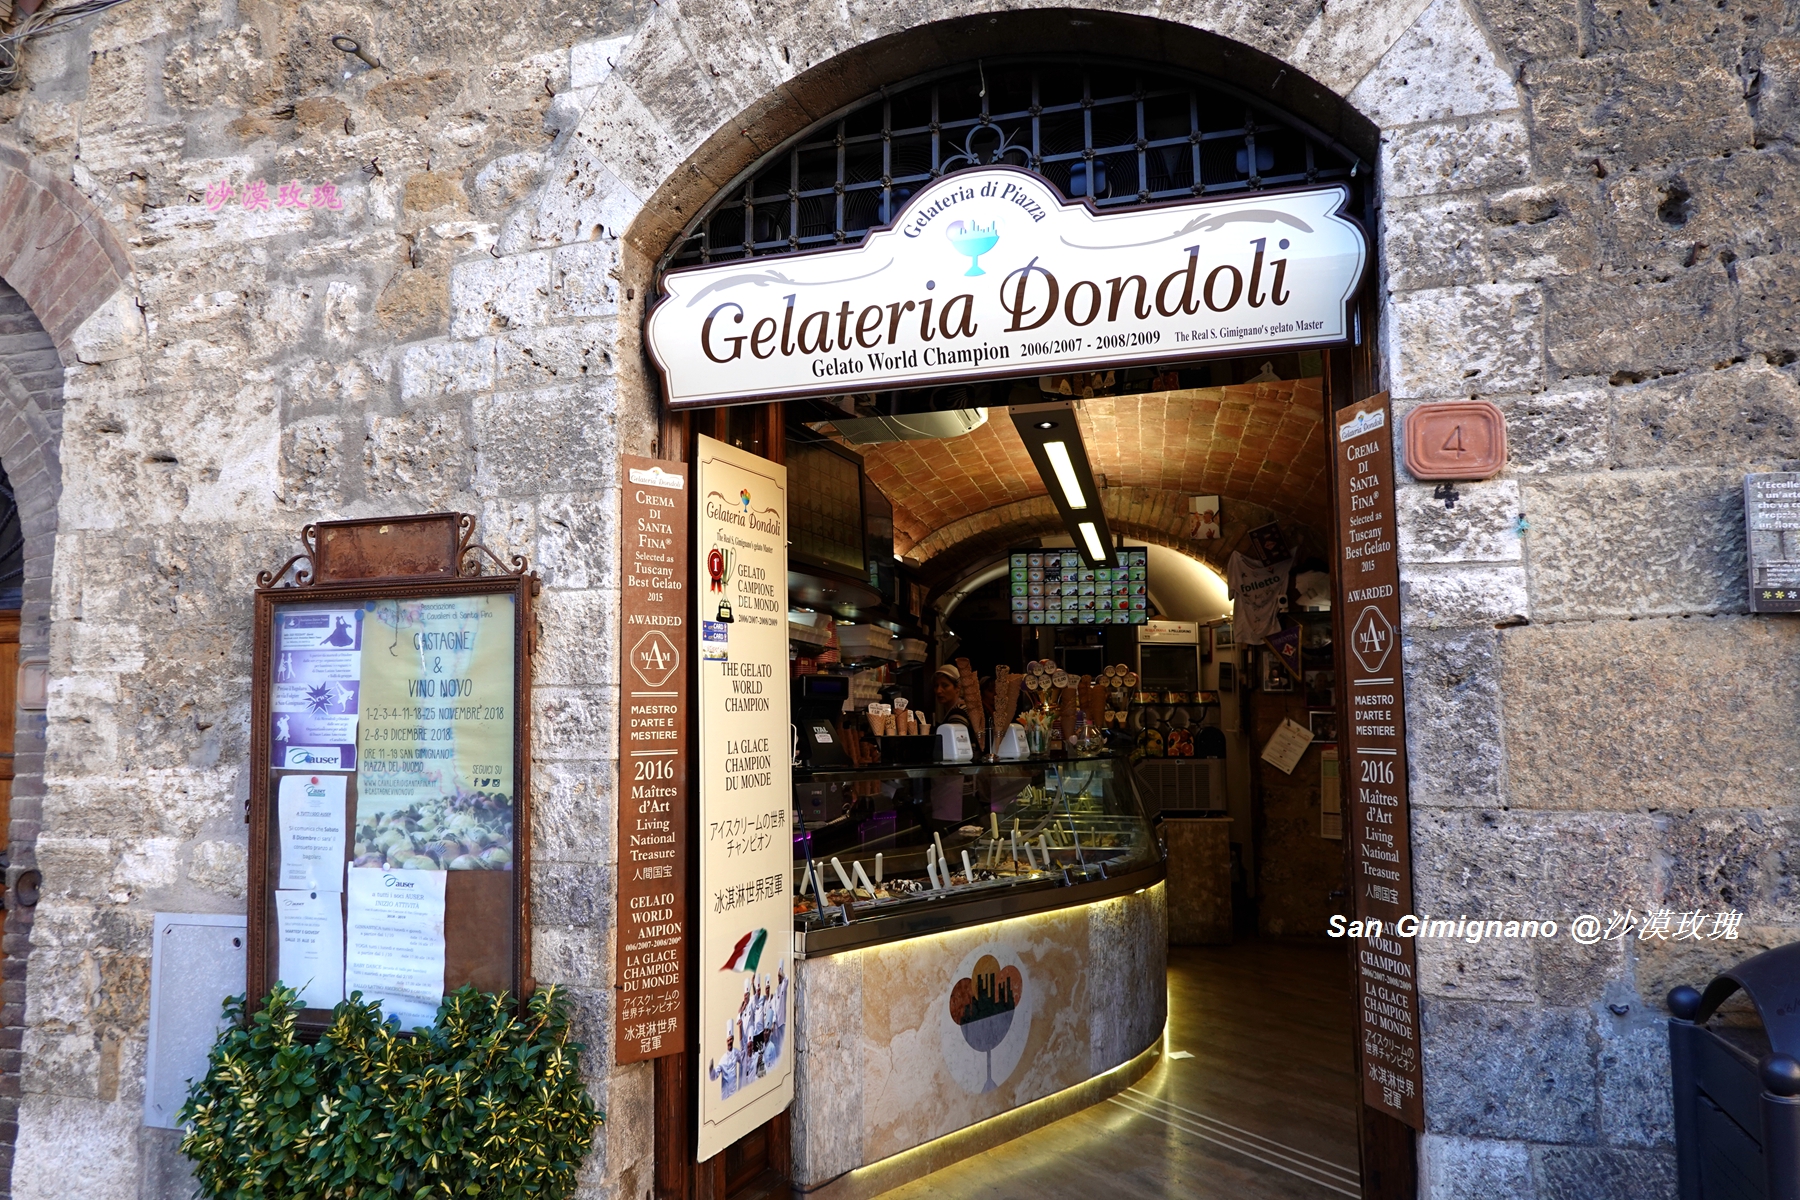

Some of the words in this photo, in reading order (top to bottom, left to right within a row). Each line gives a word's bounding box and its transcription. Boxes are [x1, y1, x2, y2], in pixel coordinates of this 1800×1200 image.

[903, 186, 975, 239] Gelateria
[980, 181, 999, 197] di
[1000, 183, 1047, 223] Piazza
[701, 280, 978, 363] Gelateria
[1000, 238, 1291, 333] Dondoli
[1174, 331, 1189, 343] The
[1191, 329, 1208, 342] Real
[1210, 328, 1218, 339] S.
[1219, 324, 1269, 340] Gimignano's
[1270, 322, 1294, 336] gelato
[1295, 319, 1324, 332] Master
[812, 357, 864, 378] Gelato
[867, 350, 918, 372] World
[923, 342, 1010, 368] Champion
[1020, 337, 1083, 358] 2006/2007
[1095, 330, 1161, 351] 2008/2009
[1342, 427, 1362, 440] Gelateria
[1363, 417, 1382, 431] Dondoli
[1347, 441, 1379, 461] CREMA
[1441, 424, 1467, 460] 4
[1358, 460, 1368, 474] DI
[631, 475, 656, 485] Gelateria
[659, 478, 681, 487] Dondoli
[1350, 474, 1379, 493] SANTA
[636, 490, 675, 508] CREMA
[649, 509, 661, 519] DI
[707, 501, 746, 527] Gelateria
[749, 512, 781, 536] Dondoli
[1350, 511, 1374, 526] Selected
[1375, 512, 1382, 520] as
[638, 518, 673, 534] SANTA
[1349, 527, 1382, 543] Tuscany
[636, 551, 665, 562] Selected
[1345, 546, 1362, 560] Best
[1364, 541, 1391, 556] Gelato
[634, 562, 673, 579] Tuscany
[737, 563, 766, 581] GELATO
[1361, 560, 1375, 572] 2015
[628, 575, 649, 587] Best
[652, 577, 682, 589] Gelato
[738, 579, 774, 597] CAMPIONE
[1240, 575, 1281, 593] folletto
[647, 592, 663, 601] 2015
[1347, 584, 1393, 603] AWARDED
[738, 595, 753, 610] DEL
[754, 597, 779, 613] MONDO
[427, 612, 451, 620] Cavalieri
[459, 611, 479, 619] Santa
[481, 611, 493, 619] Fina
[628, 615, 682, 626] AWARDED
[413, 631, 470, 650] CASTAGNE
[433, 656, 443, 674] &
[721, 662, 739, 677] THE
[740, 662, 772, 677] GELATO
[408, 679, 435, 698] VINO
[440, 678, 473, 698] NOVO
[732, 680, 763, 694] WORLD
[725, 697, 770, 712] CHAMPION
[1355, 694, 1394, 705] MAESTRO
[366, 707, 436, 720] 1-2-3-4-11-18-25
[439, 706, 481, 720] NOVEMBRE
[484, 706, 504, 720] 2018
[631, 705, 677, 714] MAESTRO
[1355, 710, 1384, 720] D'ARTE
[1385, 710, 1391, 720] E
[631, 718, 665, 727] D'ARTE
[667, 718, 674, 726] E
[1356, 725, 1395, 736] MESTIERE
[365, 728, 389, 741] 2-8-9
[391, 728, 428, 741] DICEMBRE
[431, 728, 451, 741] 2018
[631, 731, 677, 740] MESTIERE
[364, 748, 376, 759] ORE
[378, 748, 385, 759] 11
[400, 748, 413, 759] SAN
[414, 748, 450, 759] GIMIGNANO
[727, 740, 739, 754] LA
[740, 738, 769, 754] GLACE
[364, 761, 386, 772] PIAZZA
[388, 761, 399, 772] DEL
[402, 761, 424, 772] DUOMO
[472, 765, 493, 774] SEGUICI
[495, 765, 503, 774] SU
[634, 760, 674, 780] 2016
[725, 755, 771, 773] CHAMPION
[1361, 760, 1394, 785] 2016
[726, 776, 739, 791] DU
[740, 772, 772, 789] MONDE
[631, 785, 677, 799] Maîtres
[1359, 788, 1398, 806] Maîtres
[639, 800, 670, 813] d'Art
[1366, 806, 1392, 824] d'Art
[636, 818, 670, 832] Living
[710, 809, 785, 841] アイスクリームの世界
[630, 832, 675, 846] National
[727, 833, 772, 858] チャンピオン
[1365, 826, 1393, 848] Living
[630, 849, 675, 861] Treasure
[1361, 843, 1399, 863] National
[633, 865, 673, 881] 人間国宝
[1362, 861, 1400, 881] Treasure
[1365, 883, 1399, 905] 人間国宝
[632, 909, 673, 923] WORLD
[628, 922, 682, 939] AMPION
[1368, 936, 1402, 956] WORLD
[627, 955, 640, 967] LA
[642, 949, 677, 964] GLACE
[1360, 950, 1411, 978] CHAMPION
[624, 961, 679, 980] CHAMPION
[624, 980, 640, 992] DU
[641, 973, 679, 989] MONDE
[1365, 982, 1377, 997] LA
[1378, 987, 1409, 1009] GLACE
[622, 1001, 680, 1021] 世界チャンピオン
[1364, 996, 1412, 1024] CHAMPION
[1365, 1010, 1378, 1025] DU
[1380, 1016, 1413, 1040] MONDE
[640, 1035, 662, 1054] 冠軍
[1365, 1028, 1414, 1060] アイスクリームの
[1383, 1086, 1402, 1110] 冠軍
